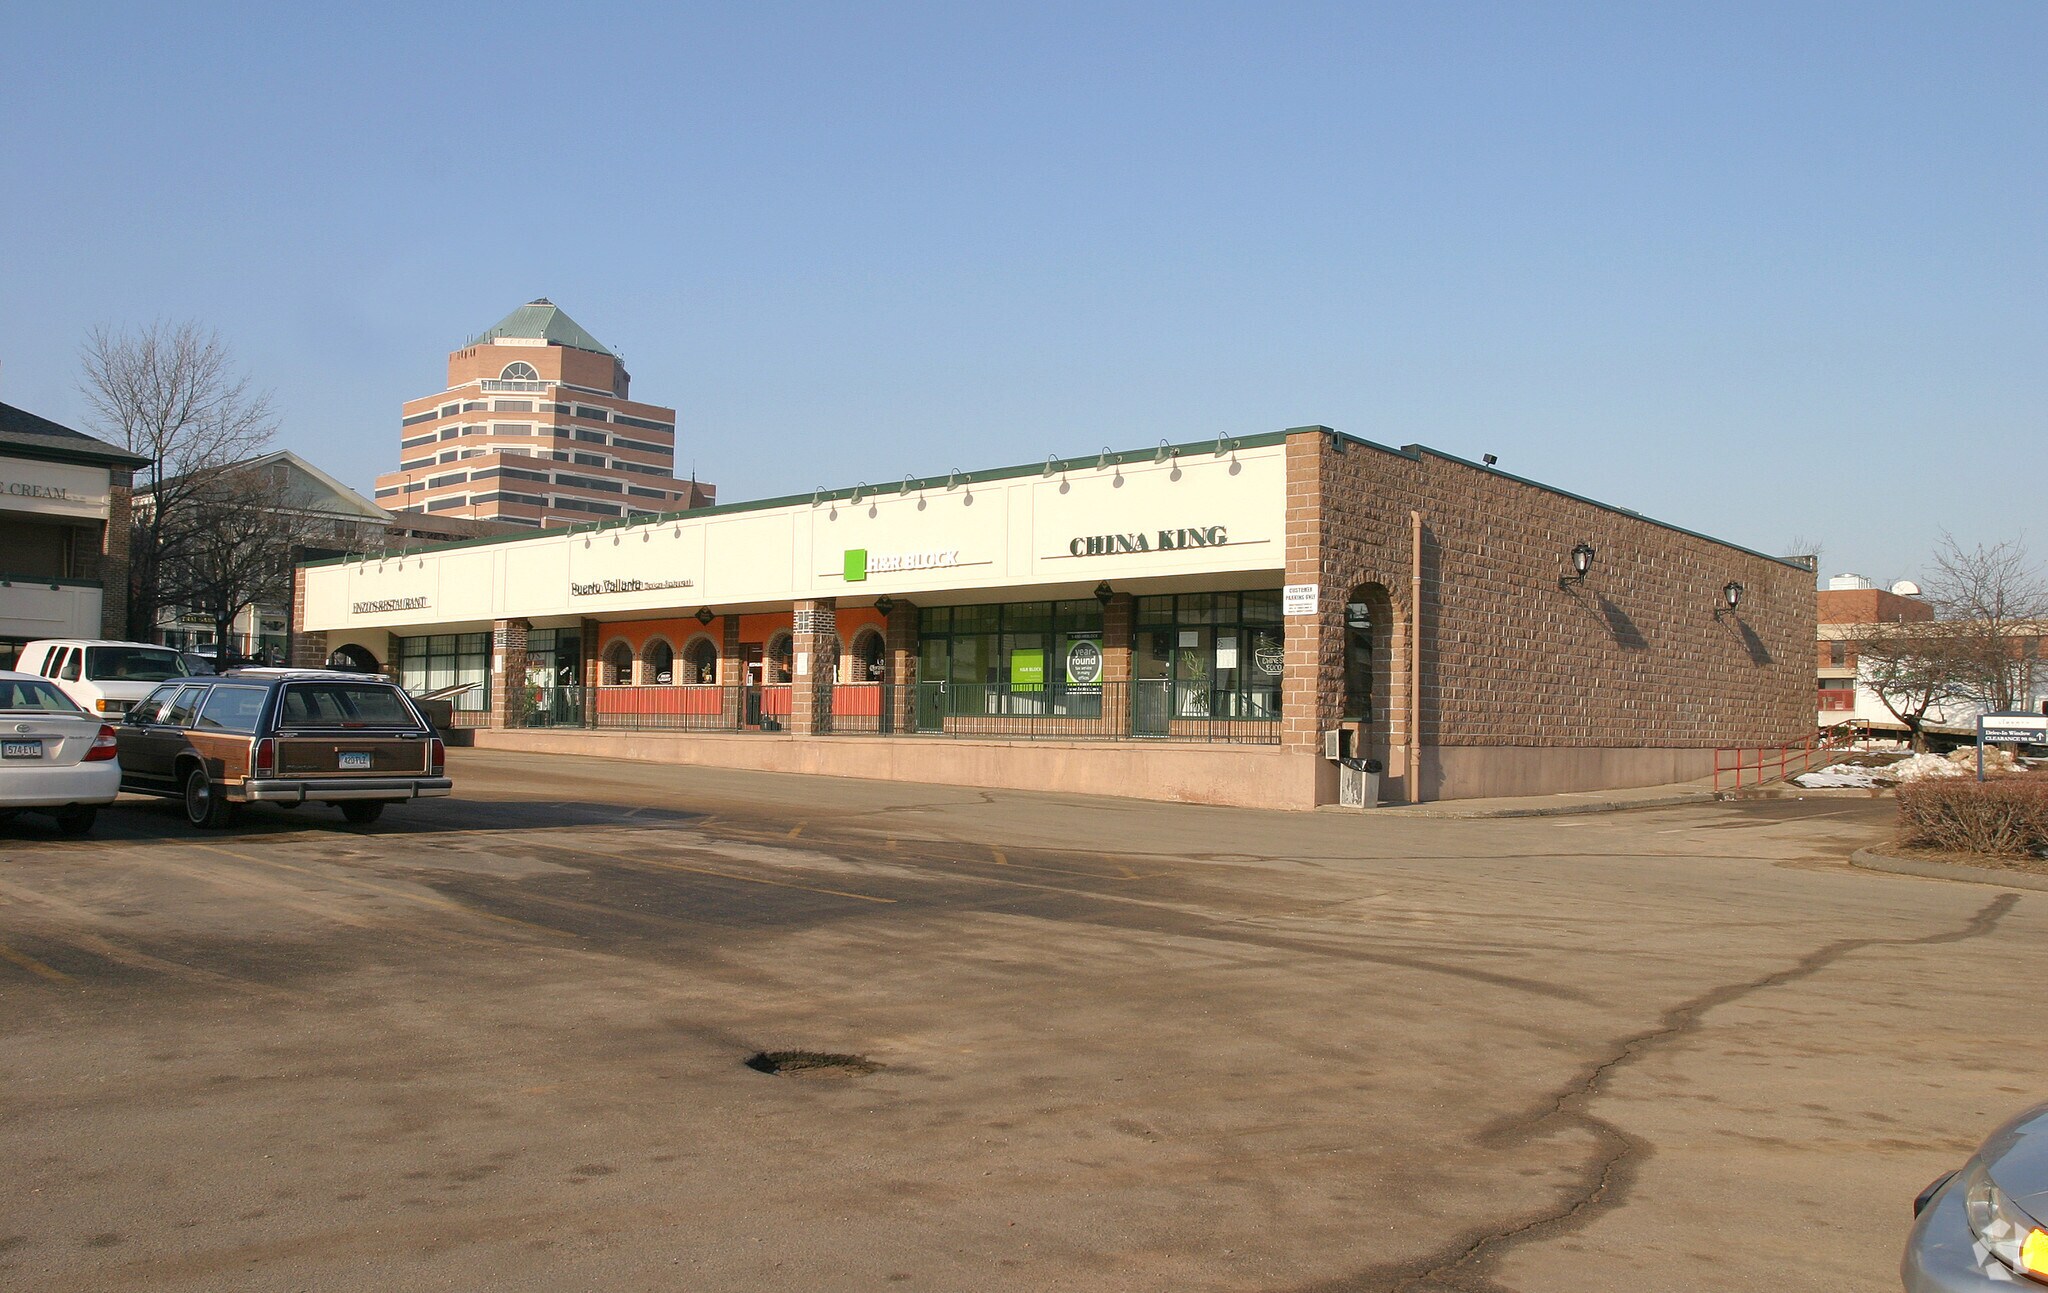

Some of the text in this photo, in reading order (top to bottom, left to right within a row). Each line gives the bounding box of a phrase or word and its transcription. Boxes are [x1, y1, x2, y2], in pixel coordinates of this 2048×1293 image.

[10, 483, 66, 499] CREAM
[1070, 525, 1228, 557] CHINA KING
[869, 550, 960, 572] H&R BLOCK
[571, 583, 603, 596] Puerto
[603, 579, 643, 593] Vallarta
[1072, 656, 1096, 665] round
[1074, 649, 1096, 657] year-
